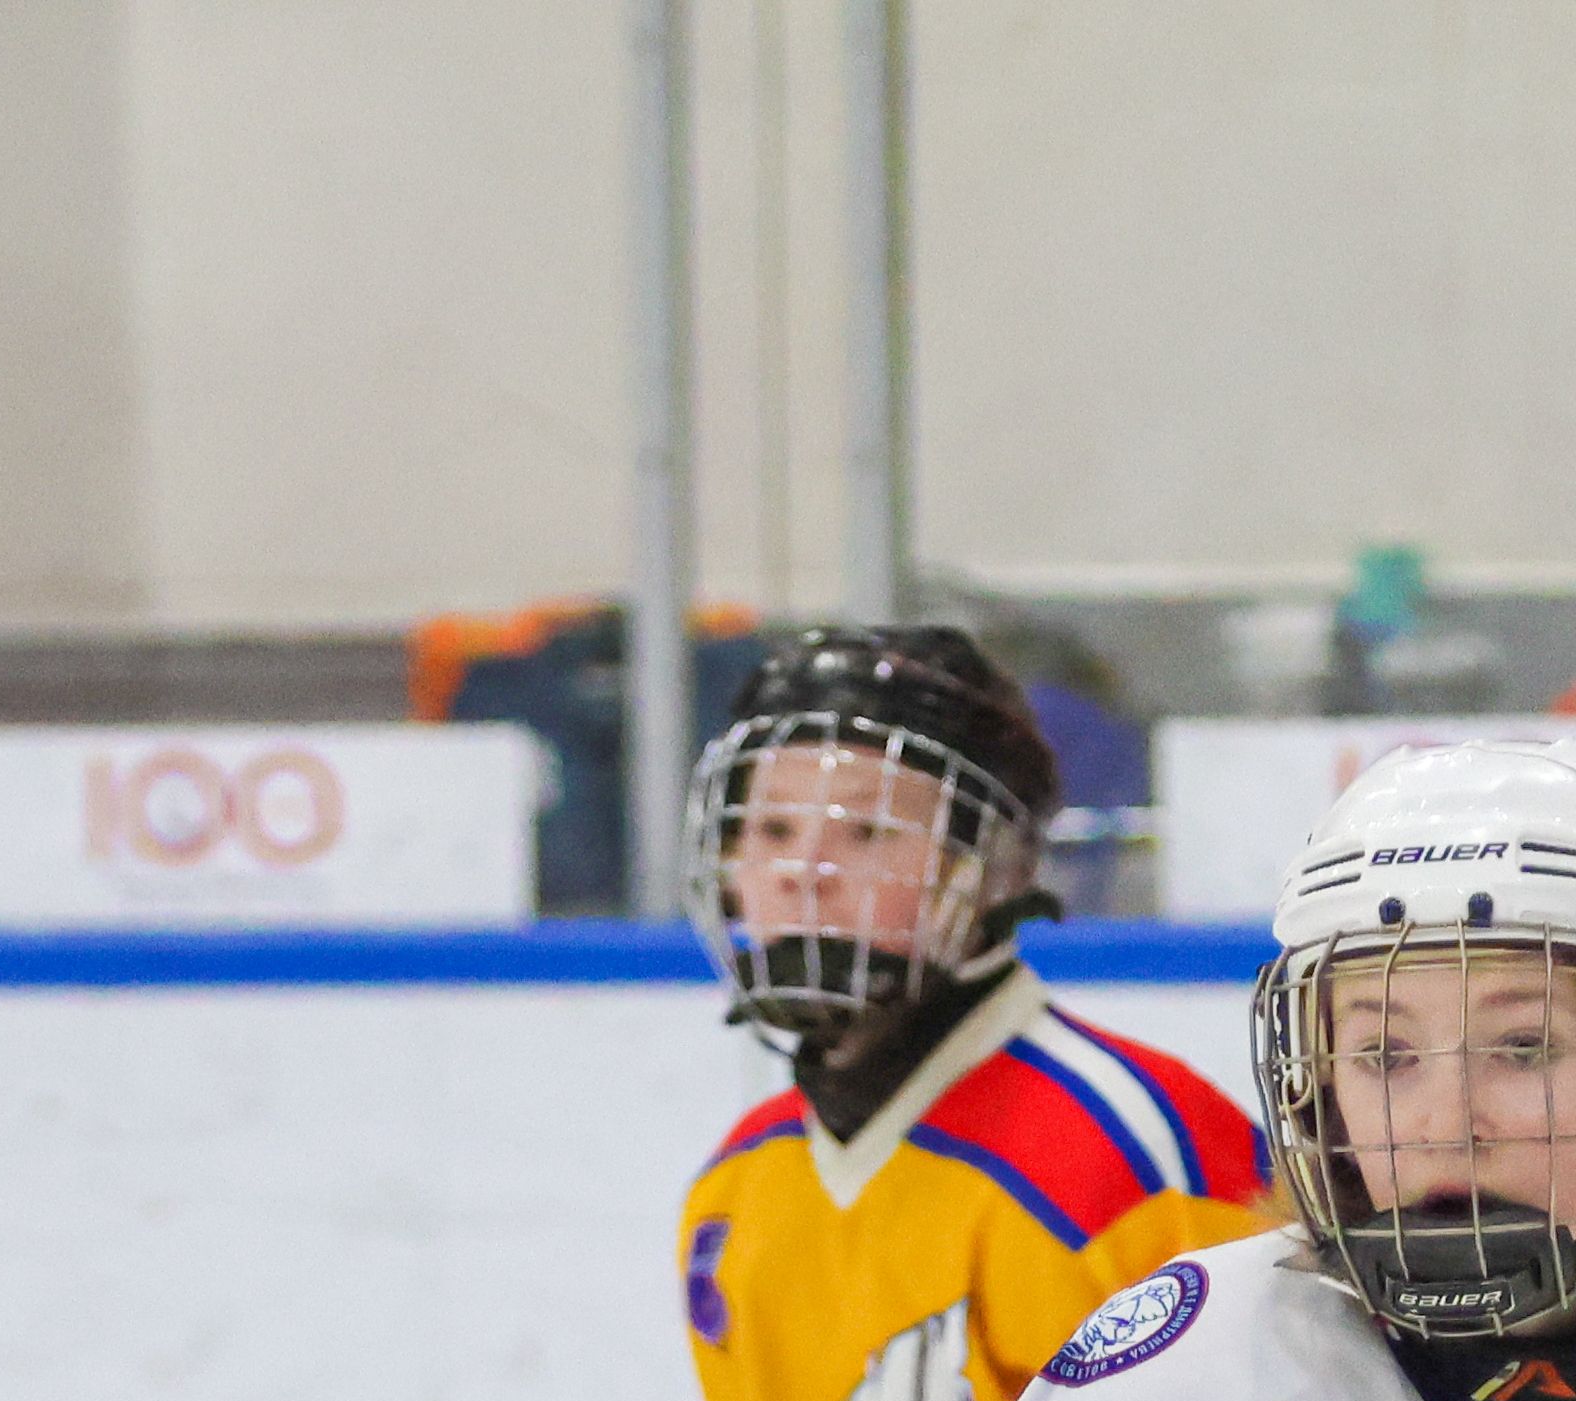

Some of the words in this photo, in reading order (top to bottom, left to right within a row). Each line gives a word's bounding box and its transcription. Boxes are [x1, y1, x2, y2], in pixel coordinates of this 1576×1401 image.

[82, 748, 345, 868] 100
[1370, 842, 1509, 866] BAUER
[1399, 1290, 1502, 1307] BAUER
